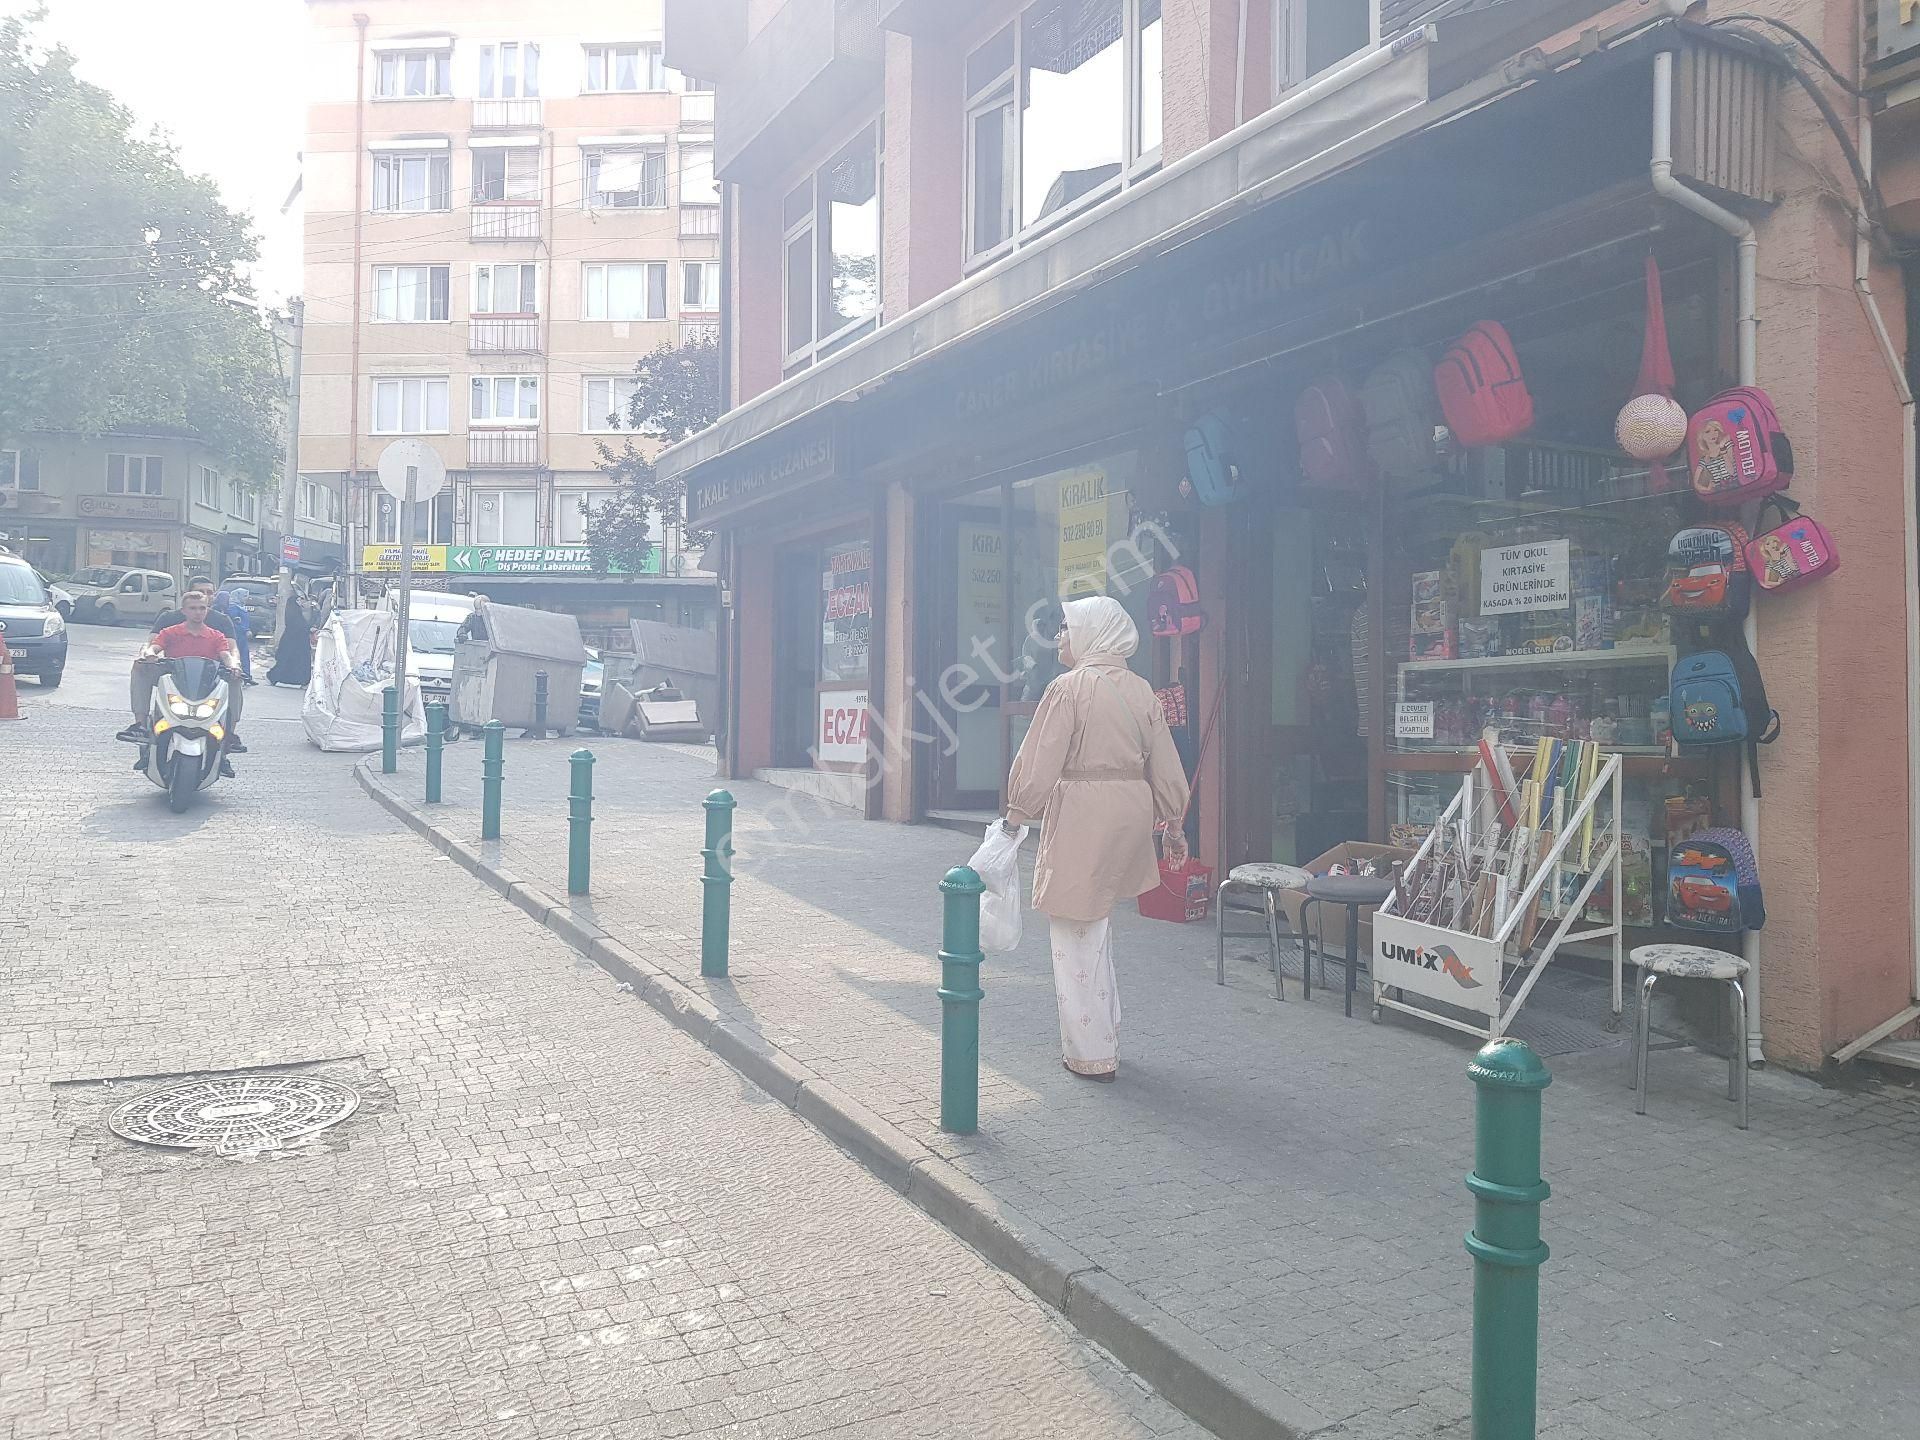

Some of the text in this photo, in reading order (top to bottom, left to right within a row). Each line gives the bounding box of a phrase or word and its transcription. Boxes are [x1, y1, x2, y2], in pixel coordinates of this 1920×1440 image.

[1735, 429, 1757, 477] FOLLOW
[495, 549, 541, 561] HEDEF
[1500, 547, 1549, 561] TÜM OKUL
[1799, 539, 1821, 567] FOLLOW
[497, 562, 510, 572] Diş
[512, 562, 541, 571] Protez
[1502, 562, 1546, 577] KIRTASİYE
[1492, 578, 1556, 593] ÜRÜNLERİNDE
[1483, 598, 1513, 608] KASADA
[1523, 596, 1533, 605] 20
[1534, 591, 1567, 604] İNDİRİM
[1535, 645, 1551, 654] CAR
